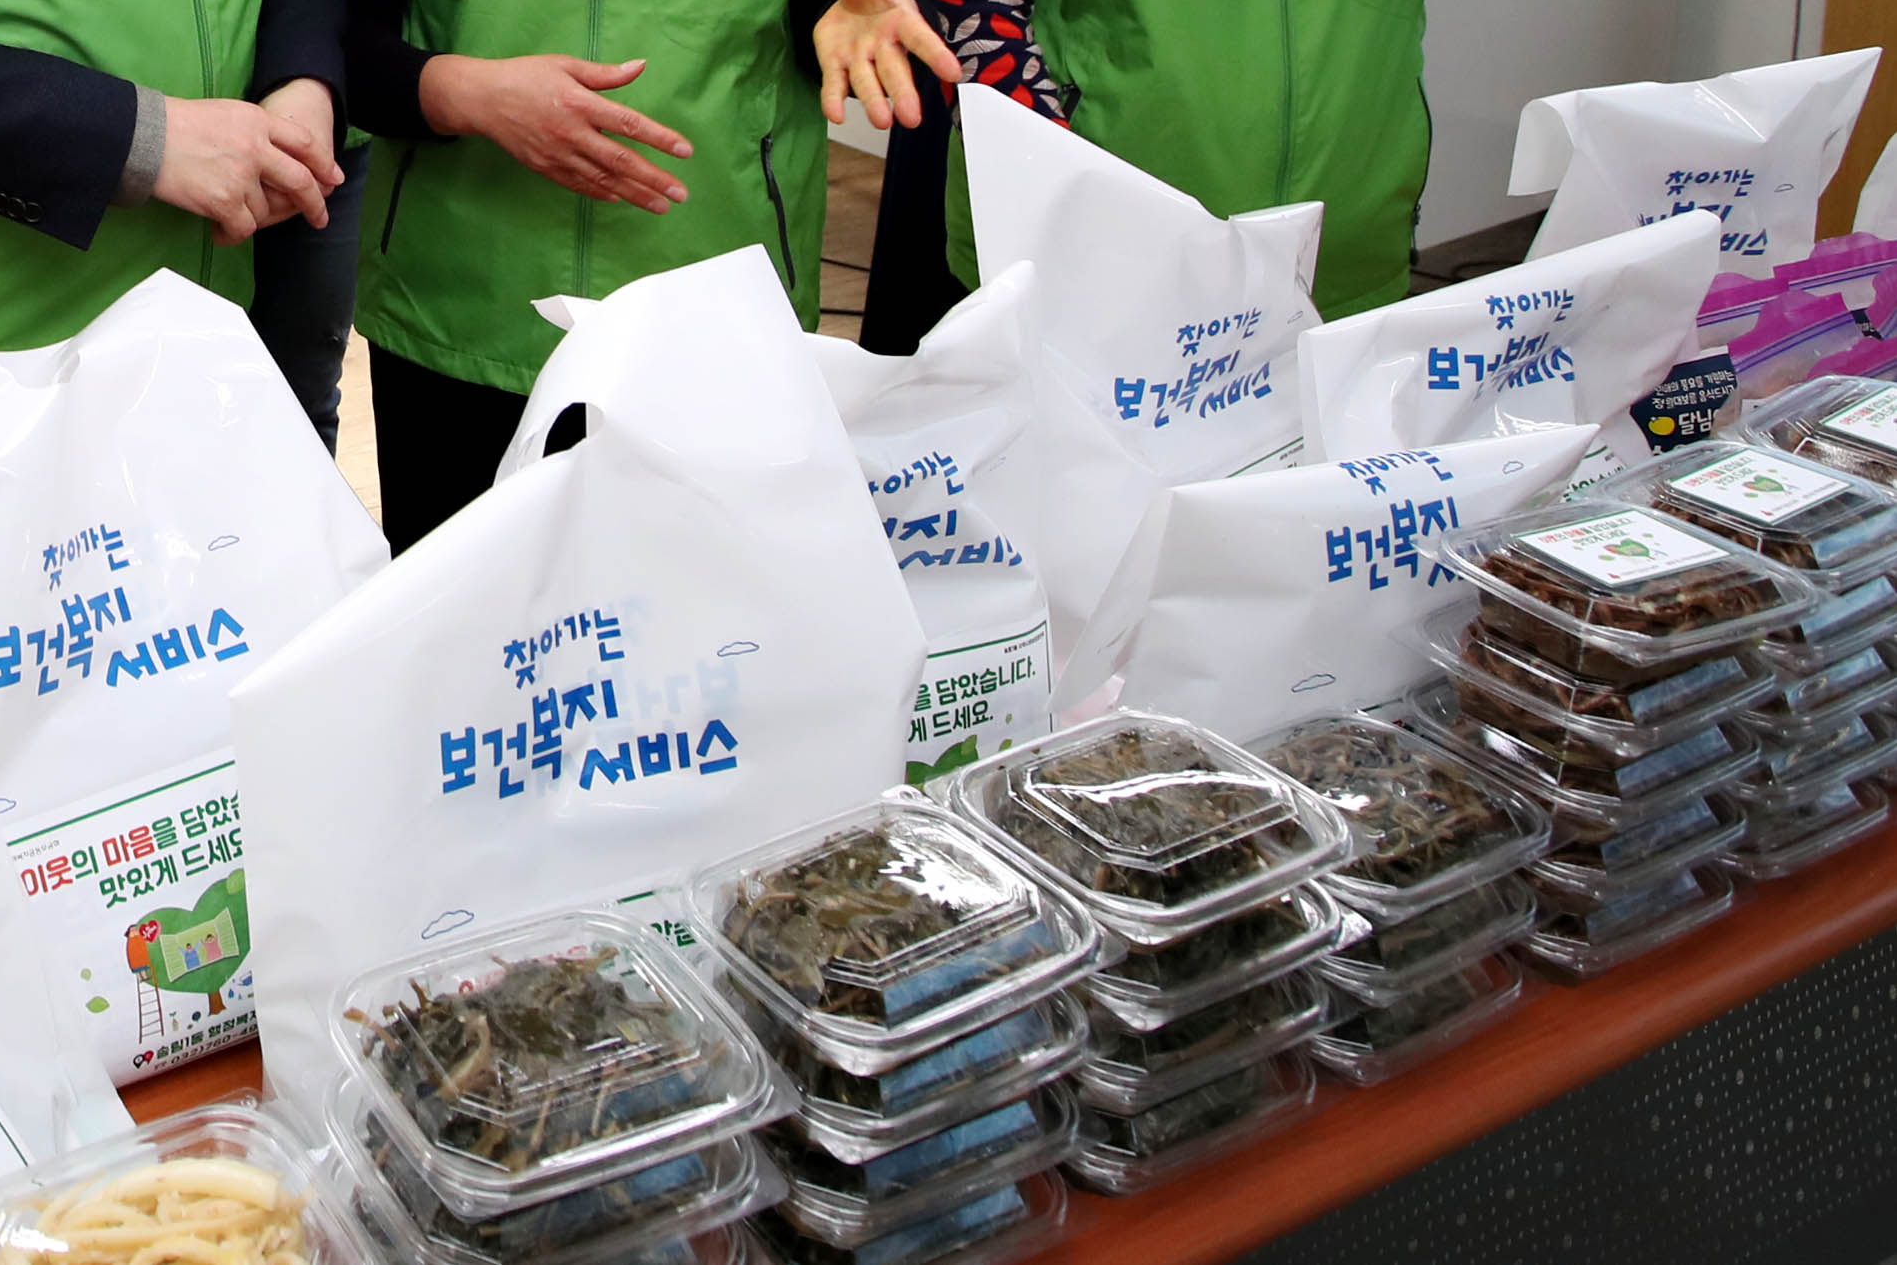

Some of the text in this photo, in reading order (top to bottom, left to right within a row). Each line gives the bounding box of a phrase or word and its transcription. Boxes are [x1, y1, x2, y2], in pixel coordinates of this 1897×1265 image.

[1664, 168, 1756, 197] 찾아가는
[1176, 307, 1263, 358] 찾아가는
[1484, 288, 1575, 331] 찾아가는
[1113, 349, 1273, 429] 보건복지 서비스
[1678, 408, 1720, 436] 달님
[868, 451, 965, 496] 아가는
[1337, 449, 1455, 496] 찾아가는
[42, 523, 131, 592] 찾아가는
[1325, 496, 1461, 592] 보건복지
[105, 607, 250, 688] 서비스
[503, 609, 626, 690] 찾아가는
[935, 655, 1037, 706] 담았습니다.
[440, 679, 619, 800] 보건복지
[578, 719, 739, 791] 서비스
[932, 700, 994, 738] 드세요.
[19, 846, 99, 896] 이웃의
[102, 816, 180, 868] 마음을
[99, 854, 180, 909] 맛있게
